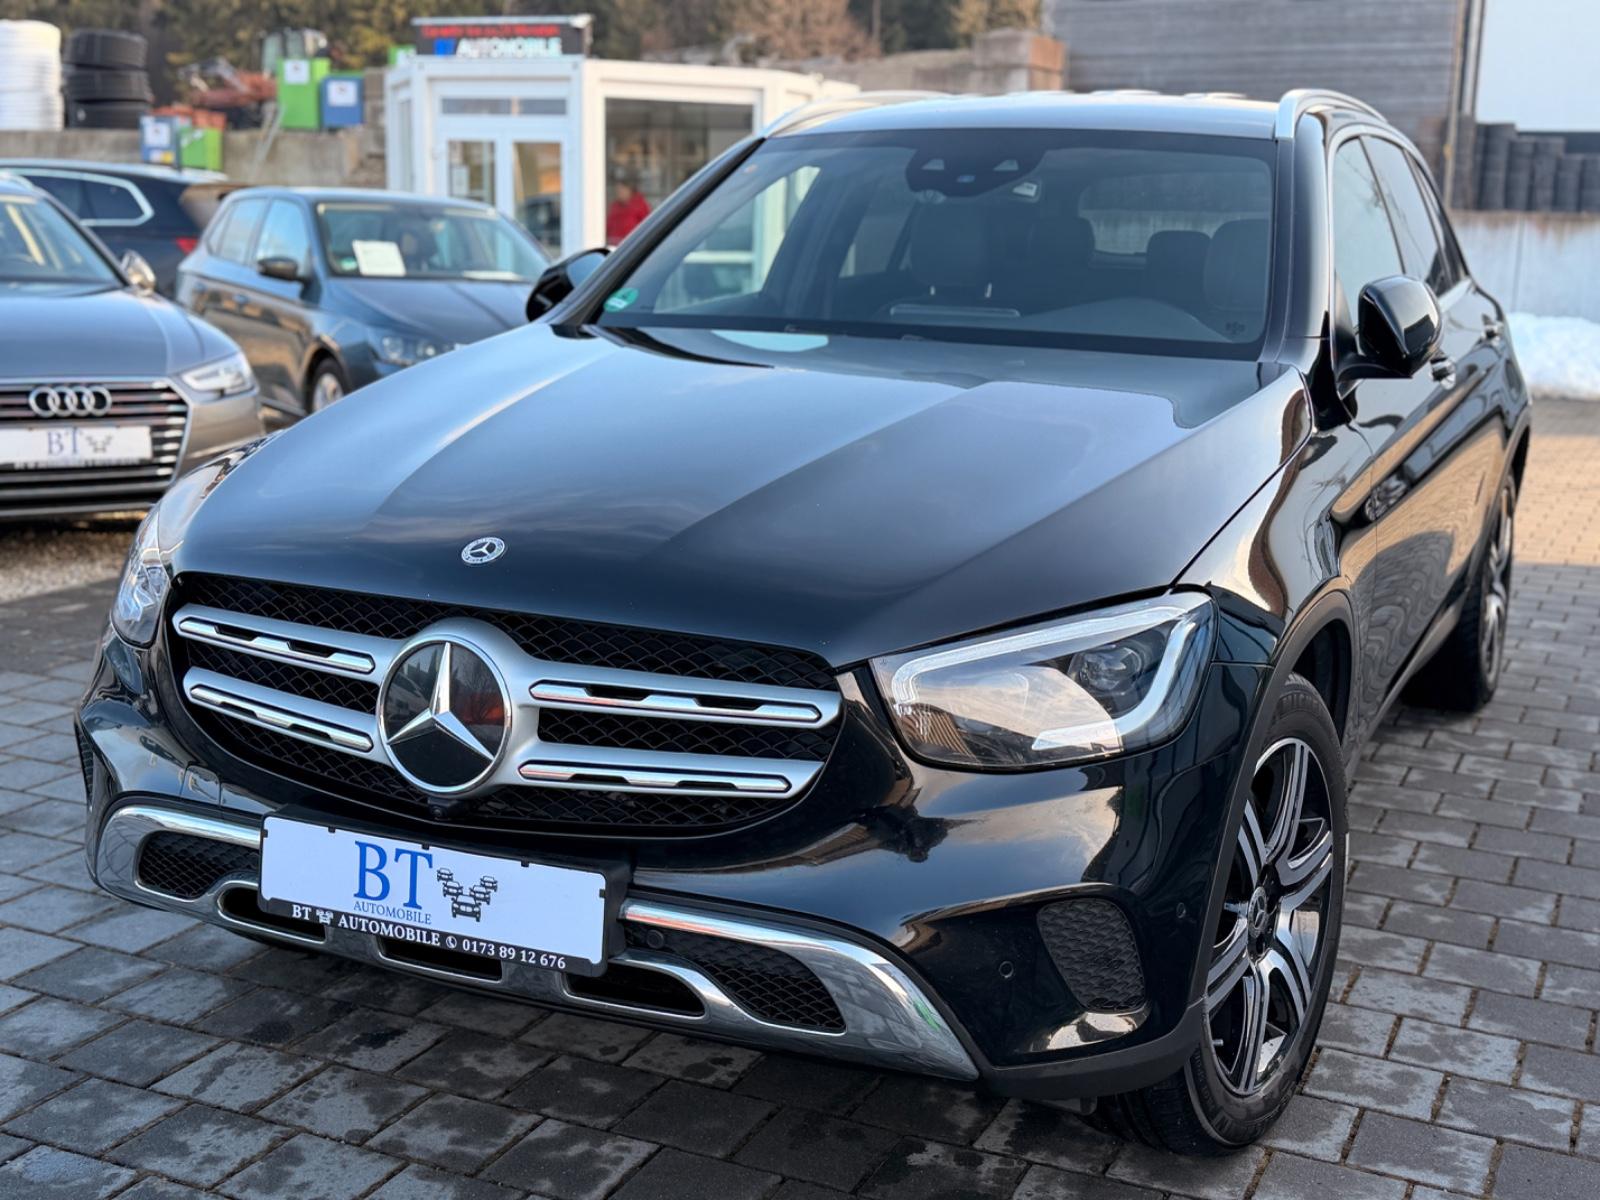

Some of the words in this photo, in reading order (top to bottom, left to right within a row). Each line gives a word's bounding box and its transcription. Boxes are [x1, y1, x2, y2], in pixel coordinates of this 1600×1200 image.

[47, 426, 83, 455] BT
[353, 840, 433, 910] BT
[292, 904, 312, 921] BT
[338, 915, 441, 946] AUTOMOBILE
[462, 939, 495, 956] 0173
[499, 945, 516, 960] 89
[520, 949, 536, 964] 12
[540, 953, 566, 969] 676
[353, 901, 432, 925] AUTOMOBILE
